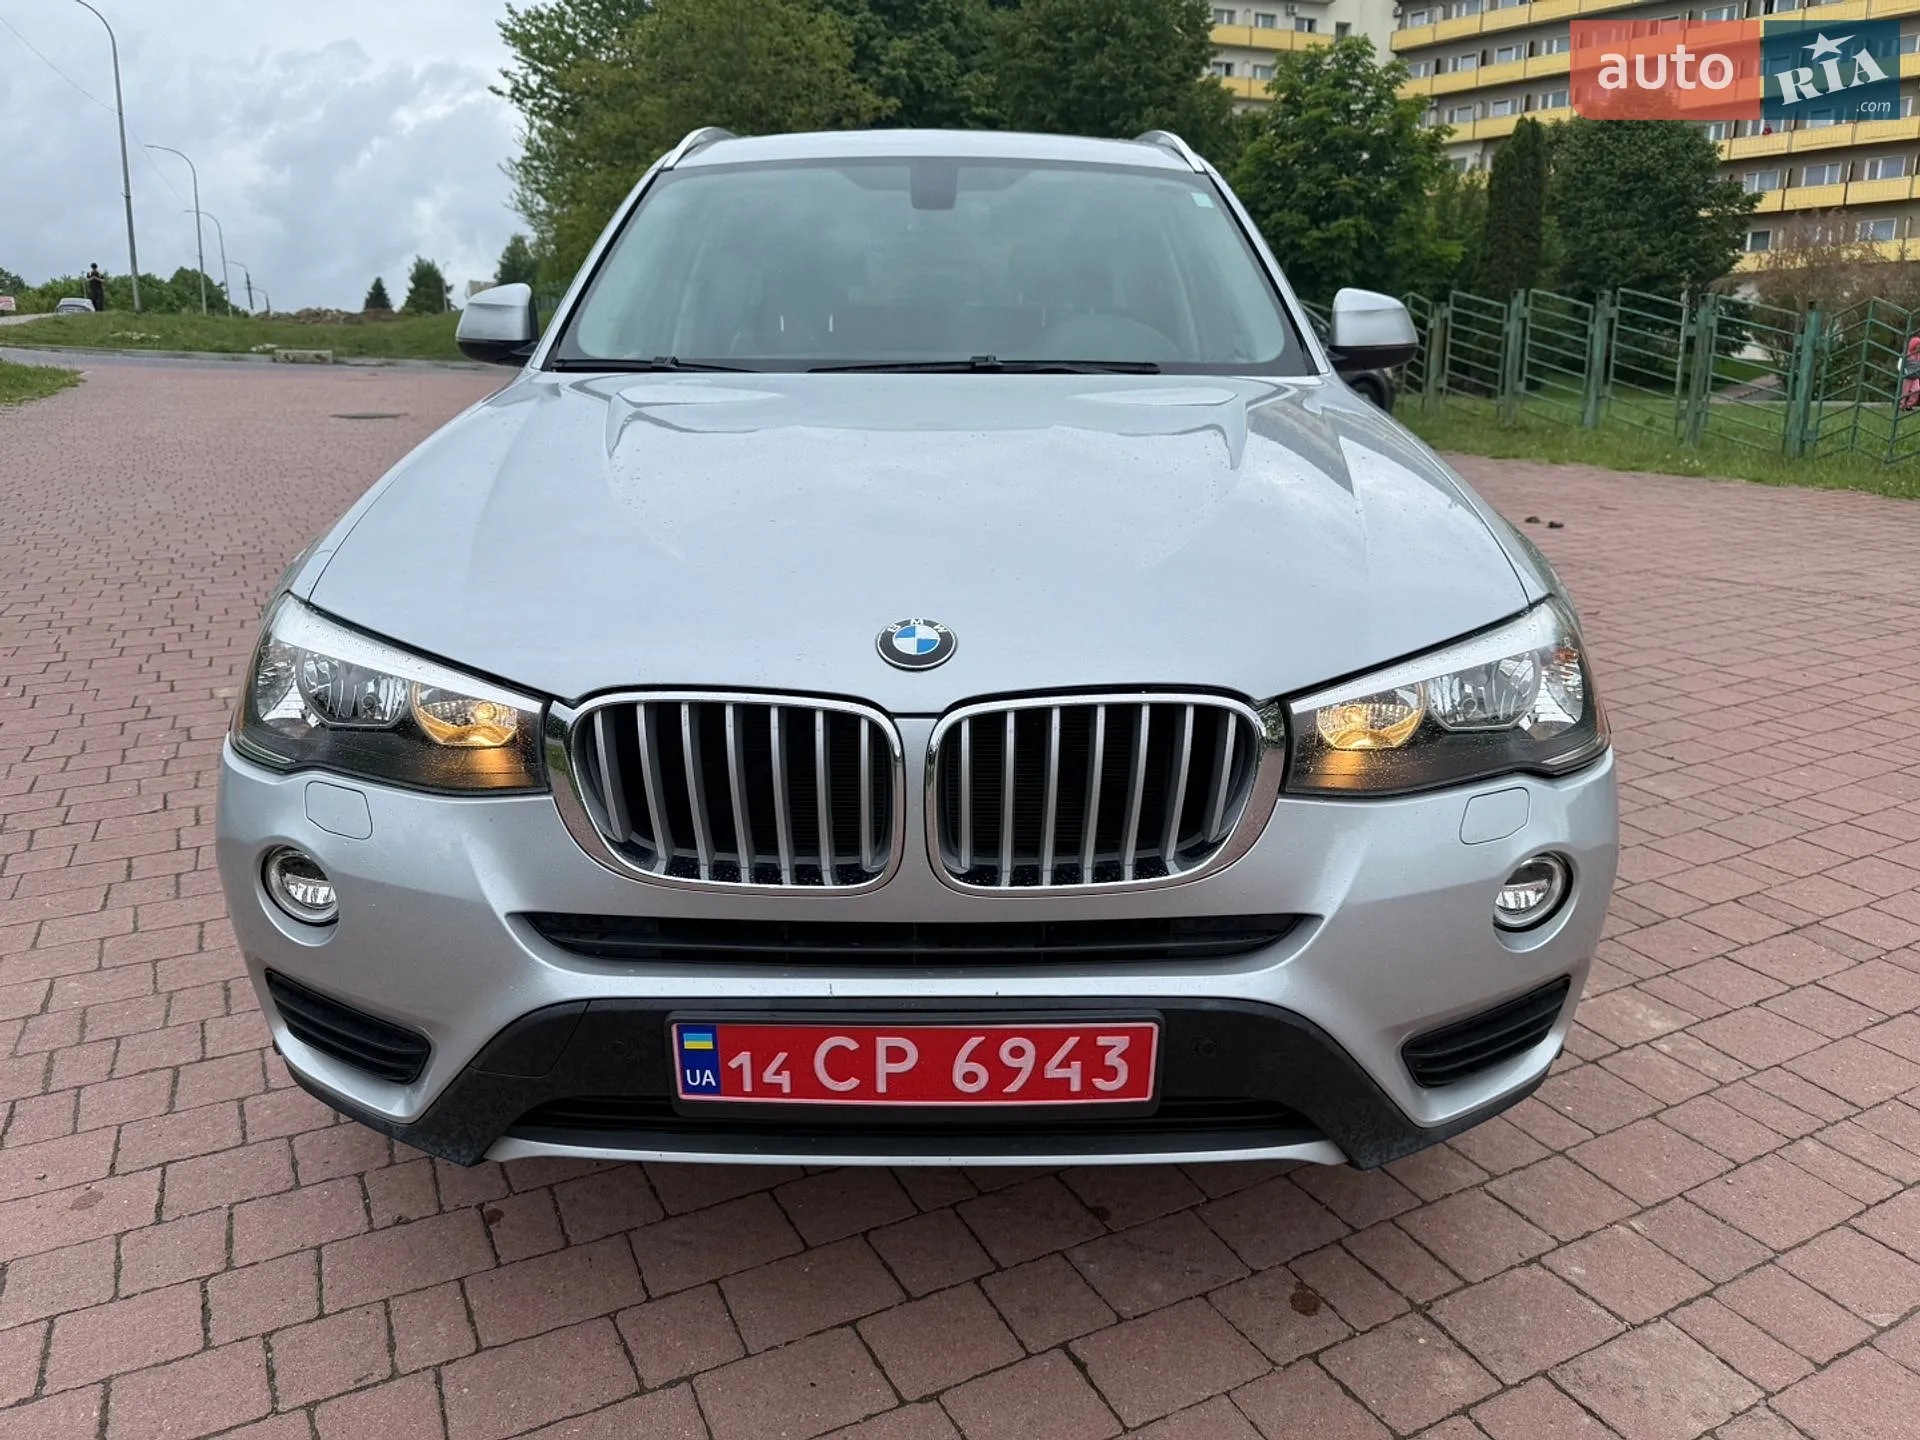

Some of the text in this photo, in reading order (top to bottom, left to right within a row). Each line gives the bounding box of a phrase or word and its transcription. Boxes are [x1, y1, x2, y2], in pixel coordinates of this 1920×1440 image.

[686, 1069, 716, 1087] UA
[727, 1036, 1130, 1094] 14 CP 6943
